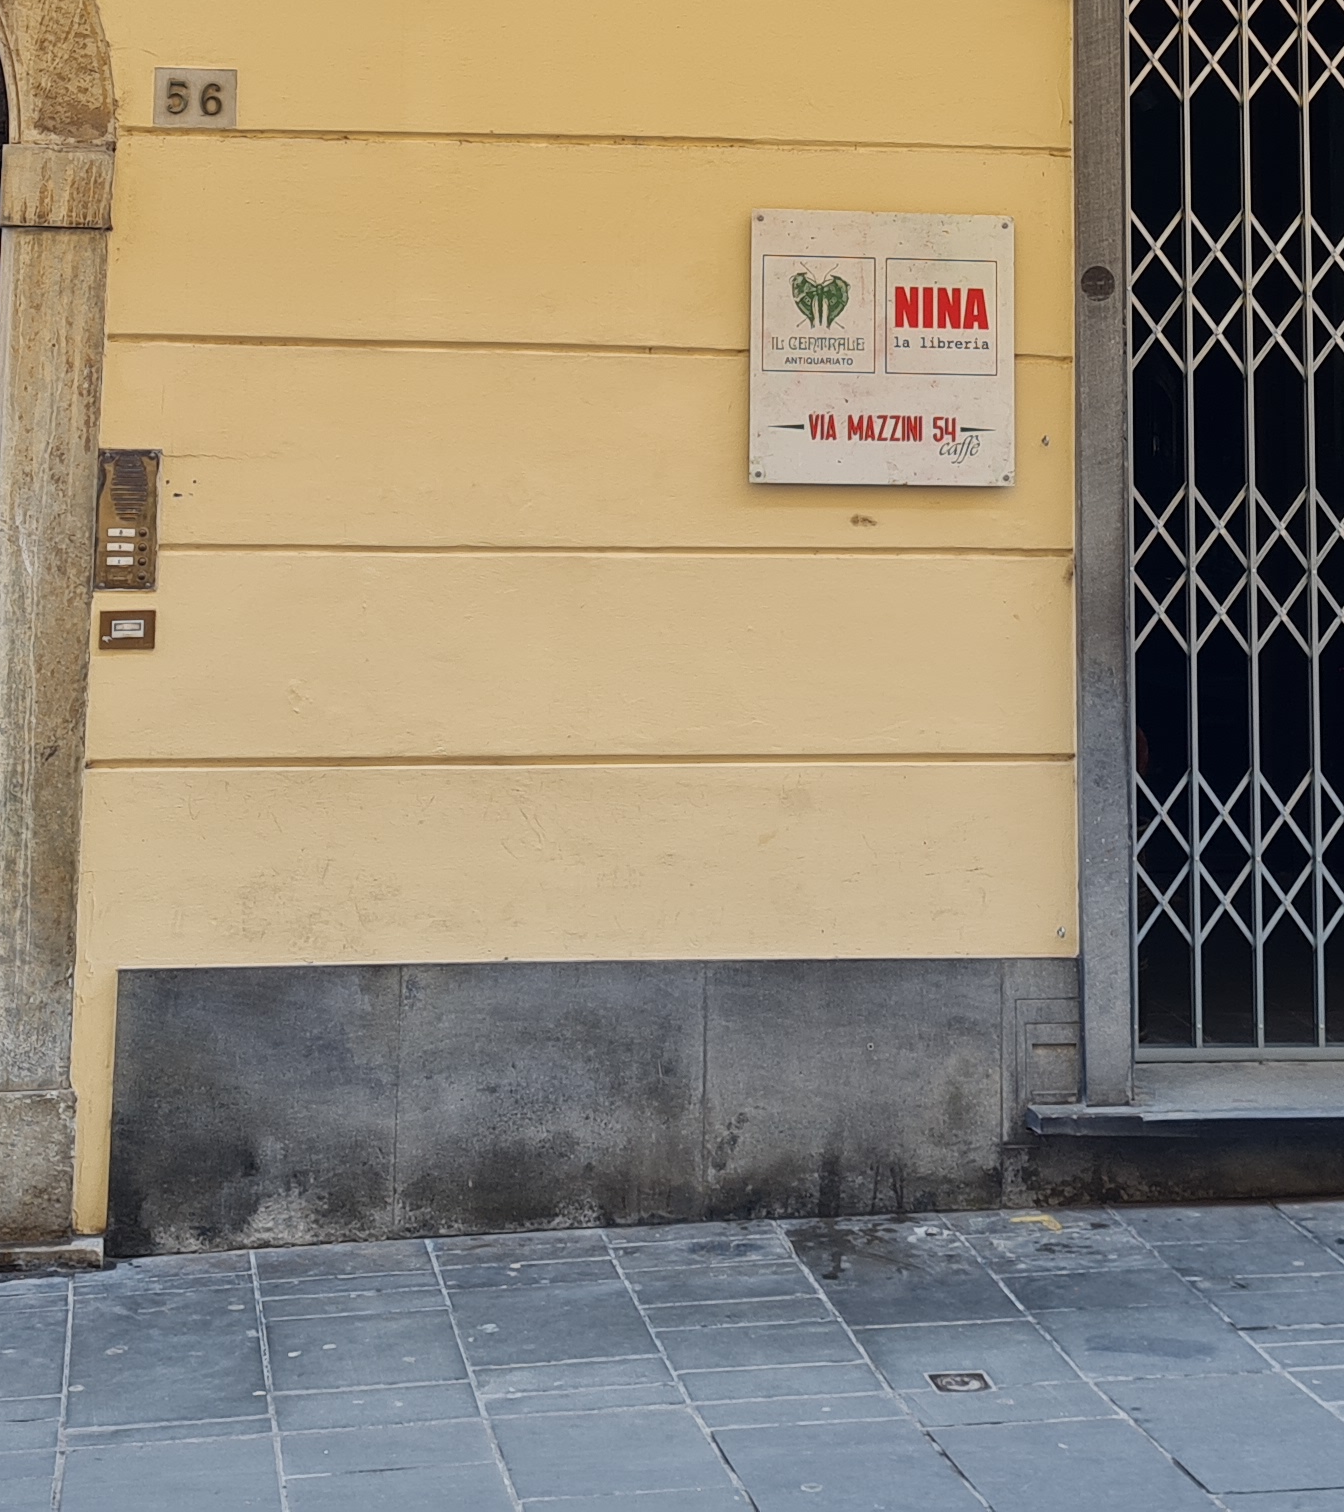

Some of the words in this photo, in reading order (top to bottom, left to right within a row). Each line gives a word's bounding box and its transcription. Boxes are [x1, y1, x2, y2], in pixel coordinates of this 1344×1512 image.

[166, 80, 223, 116] 56
[894, 285, 990, 331] NINA
[771, 336, 785, 351] IL
[788, 336, 865, 354] CENTRALE
[893, 336, 911, 349] la
[920, 336, 990, 351] libreria
[784, 356, 854, 366] ANTIQUARIATO
[808, 413, 837, 441] VIA
[847, 414, 923, 442] MAZZINI
[932, 416, 957, 443] 54
[938, 434, 981, 465] caffè
